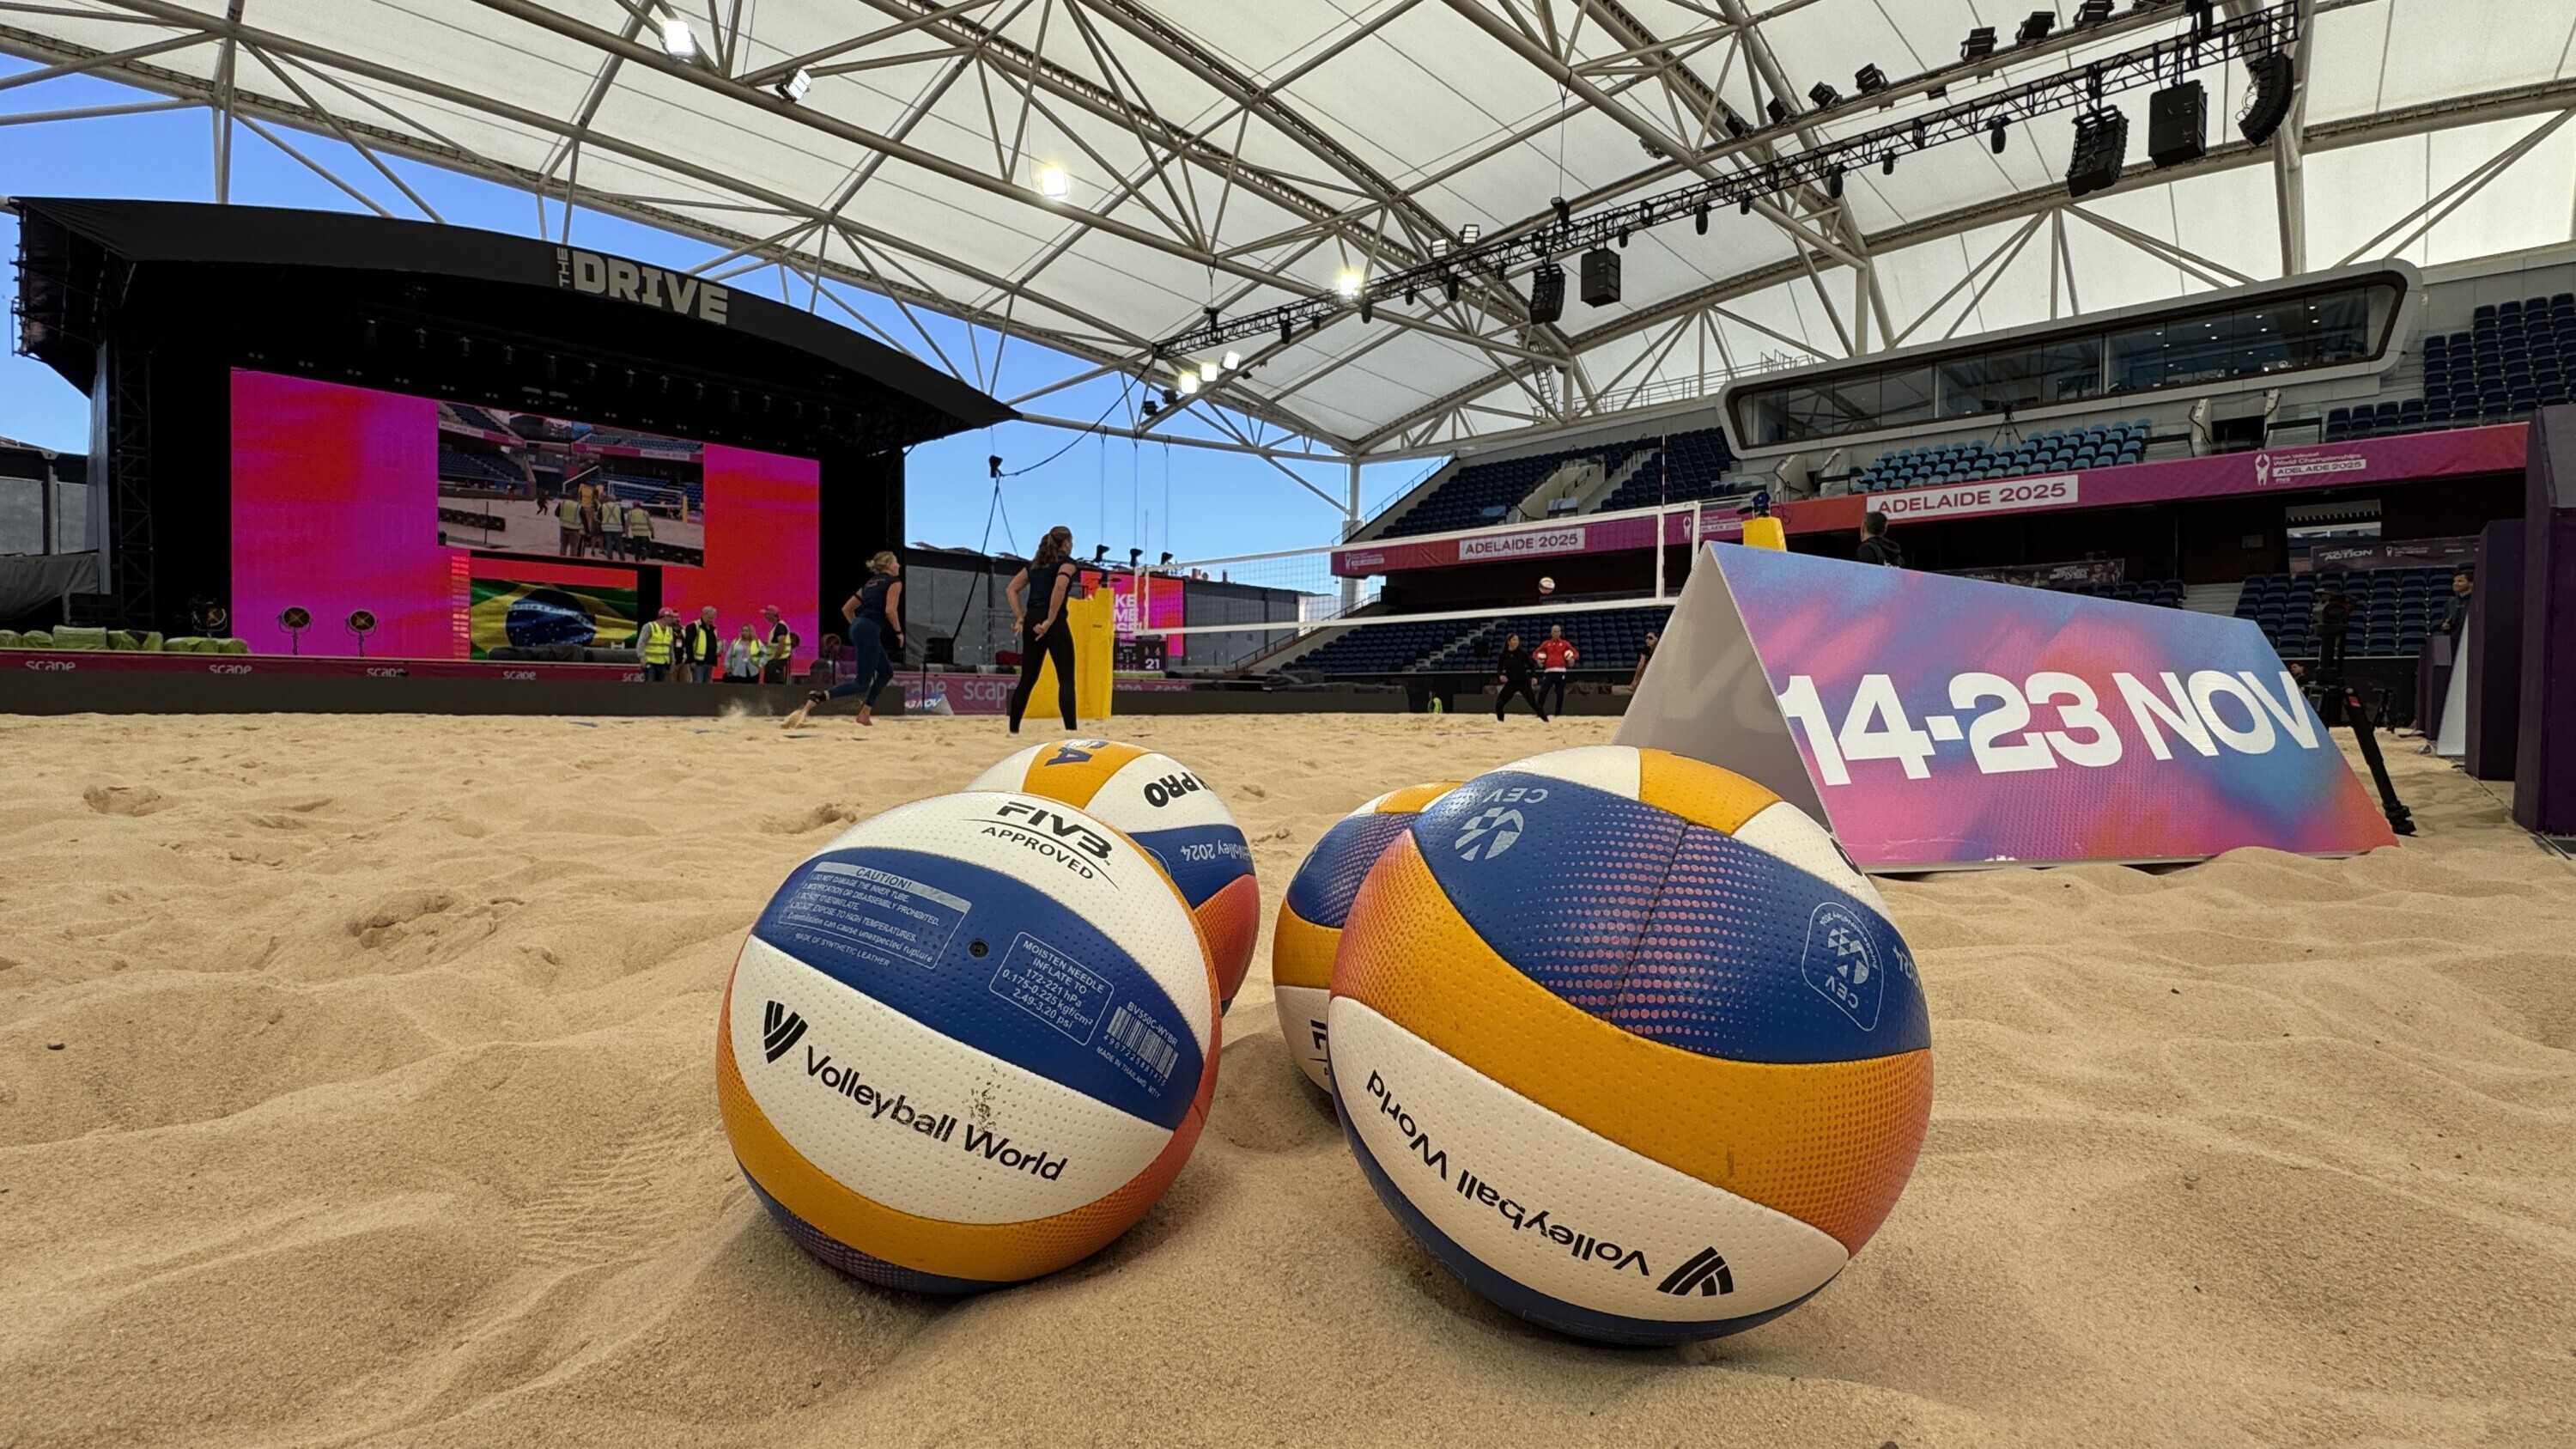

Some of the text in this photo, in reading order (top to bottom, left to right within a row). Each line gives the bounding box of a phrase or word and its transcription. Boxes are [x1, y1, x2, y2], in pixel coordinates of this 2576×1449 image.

[556, 247, 728, 326] THE DRIVE
[2277, 461, 2362, 475] ADELAIDE 2025
[2299, 454, 2361, 464] Championships
[1879, 483, 2067, 514] ADELAIDE 2025
[1465, 533, 1578, 555] ADELAIDE 2025
[2324, 550, 2372, 561] ACTION
[623, 673, 645, 682] scap
[1145, 658, 1160, 670] 21
[1777, 670, 2319, 786] 14-23 NOV
[1144, 771, 1200, 807] PRO
[1481, 787, 1549, 804] CEV
[981, 826, 1094, 880] APPROVED
[1180, 843, 1215, 861] 2024
[856, 868, 912, 890] CAUTION!
[836, 910, 846, 918] TO
[852, 892, 897, 910] DISASSEMBLY
[821, 938, 857, 955] SYNTHETIC
[857, 950, 890, 967] LEATHER
[836, 924, 858, 935] cause
[859, 929, 903, 951] unexpected
[903, 945, 933, 963] rupture
[1023, 940, 1104, 994] MOISTEN NEEDLE
[1032, 958, 1087, 994] INFLATE TO
[1002, 969, 1058, 1005] 0.175-0.225
[1026, 968, 1082, 1008] 172-221 hPa
[1825, 975, 1859, 1008] CEV
[1012, 988, 1073, 1030] 2.49-3.20 psi
[1127, 1001, 1178, 1047] BV550C-WYBR
[1096, 1045, 1115, 1063] MADE
[1114, 1058, 1122, 1068] IN
[1121, 1063, 1147, 1087] THAILAND
[806, 1044, 1068, 1181] Volleyball World
[1366, 1069, 1651, 1276] Volleyball World
